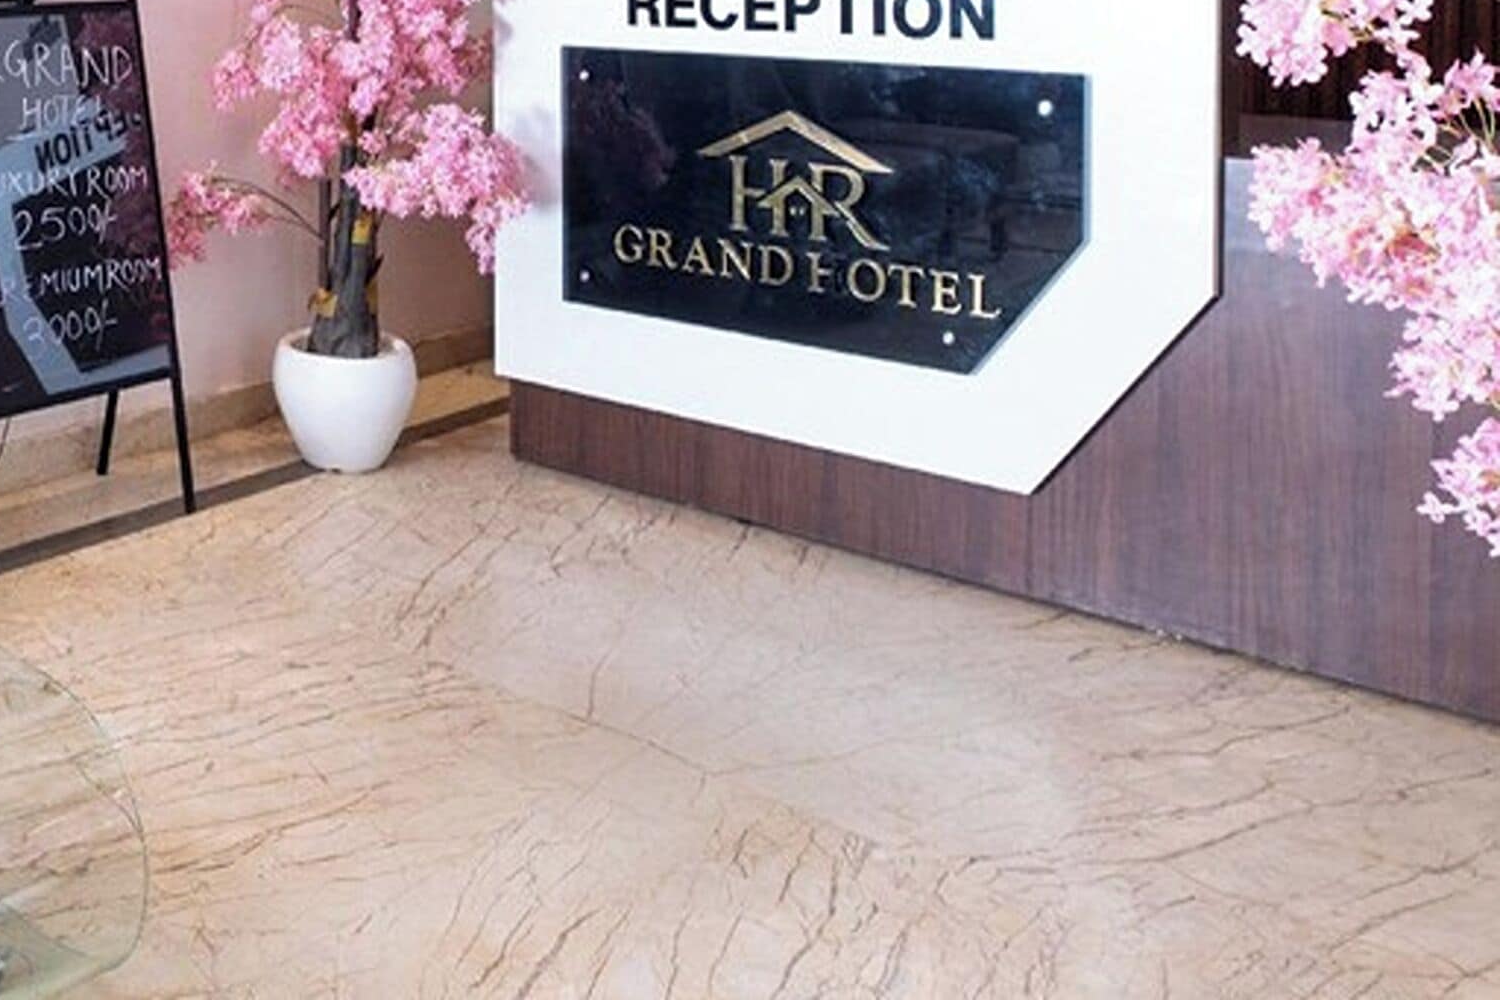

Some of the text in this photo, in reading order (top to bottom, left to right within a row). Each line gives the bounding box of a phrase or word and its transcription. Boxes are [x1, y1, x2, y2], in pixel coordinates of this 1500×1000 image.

[728, 155, 892, 252] HR
[613, 223, 1002, 320] GRAND HOTEL
